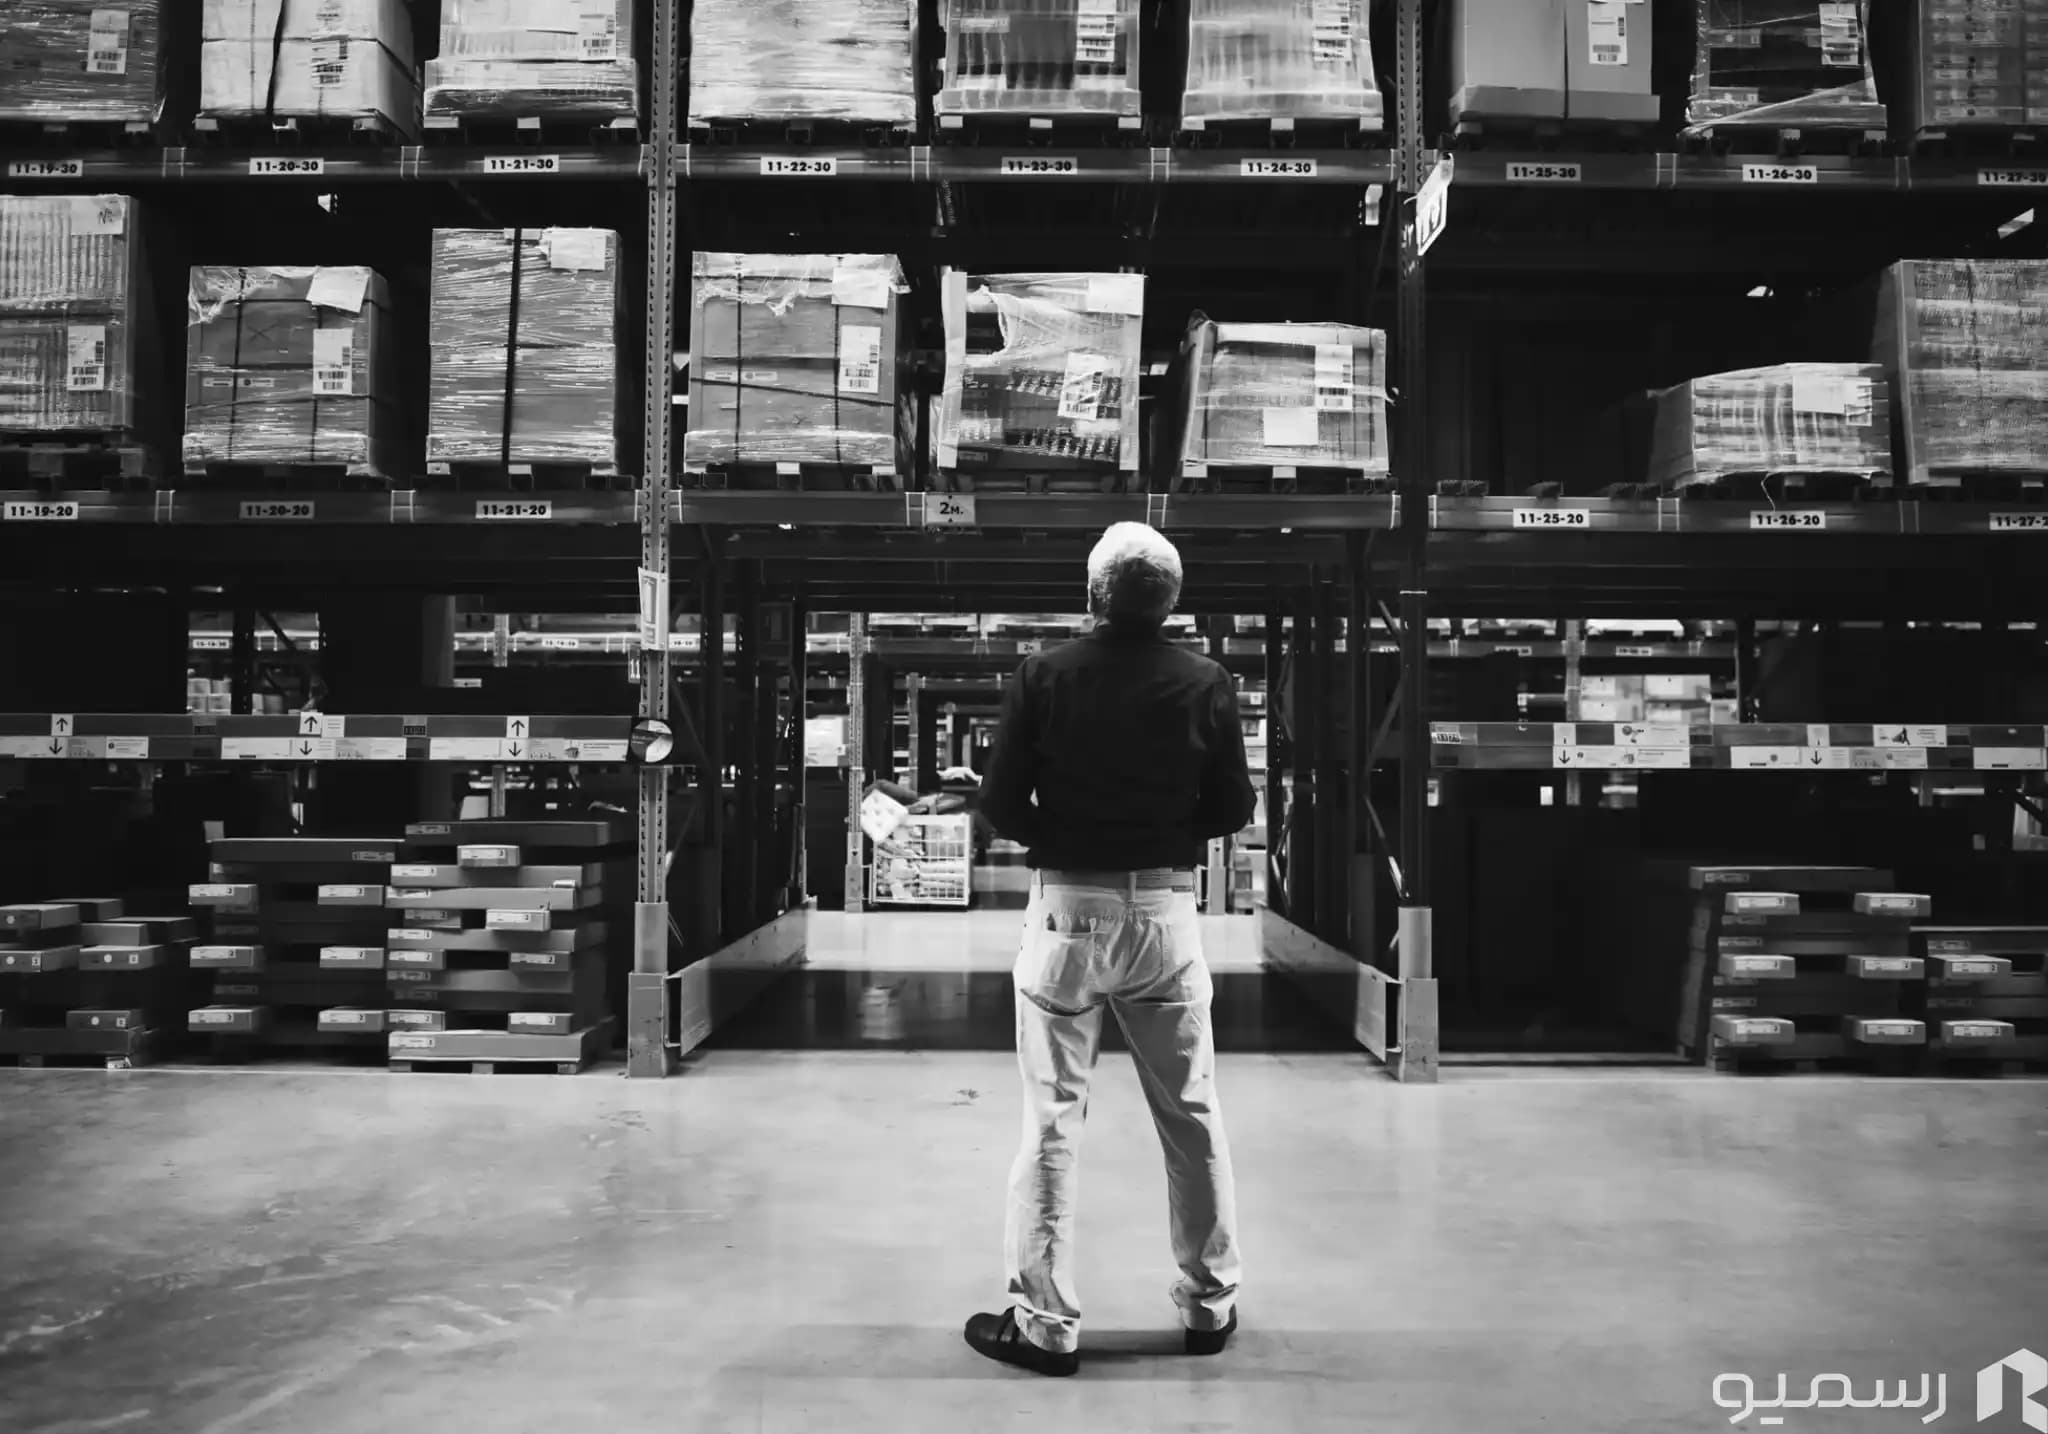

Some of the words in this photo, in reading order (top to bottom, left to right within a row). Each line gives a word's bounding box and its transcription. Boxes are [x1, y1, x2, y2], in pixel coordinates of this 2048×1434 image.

[14, 162, 78, 174] 11-19-30
[256, 160, 319, 172] 11-20-30
[491, 158, 554, 170] 11-21-30
[767, 161, 831, 172] 11-22-30
[1007, 160, 1073, 172] 11-23-30
[1247, 161, 1312, 174] 11-24-30
[1513, 166, 1577, 179] 11-25-30
[1749, 168, 1813, 180] 11-26-30
[11, 505, 73, 517] 11-19-20
[246, 504, 310, 516] 11-20-20
[482, 503, 547, 516] 11-21-20
[1520, 512, 1584, 524] 11-25-20
[1756, 514, 1820, 526] 11-26-20
